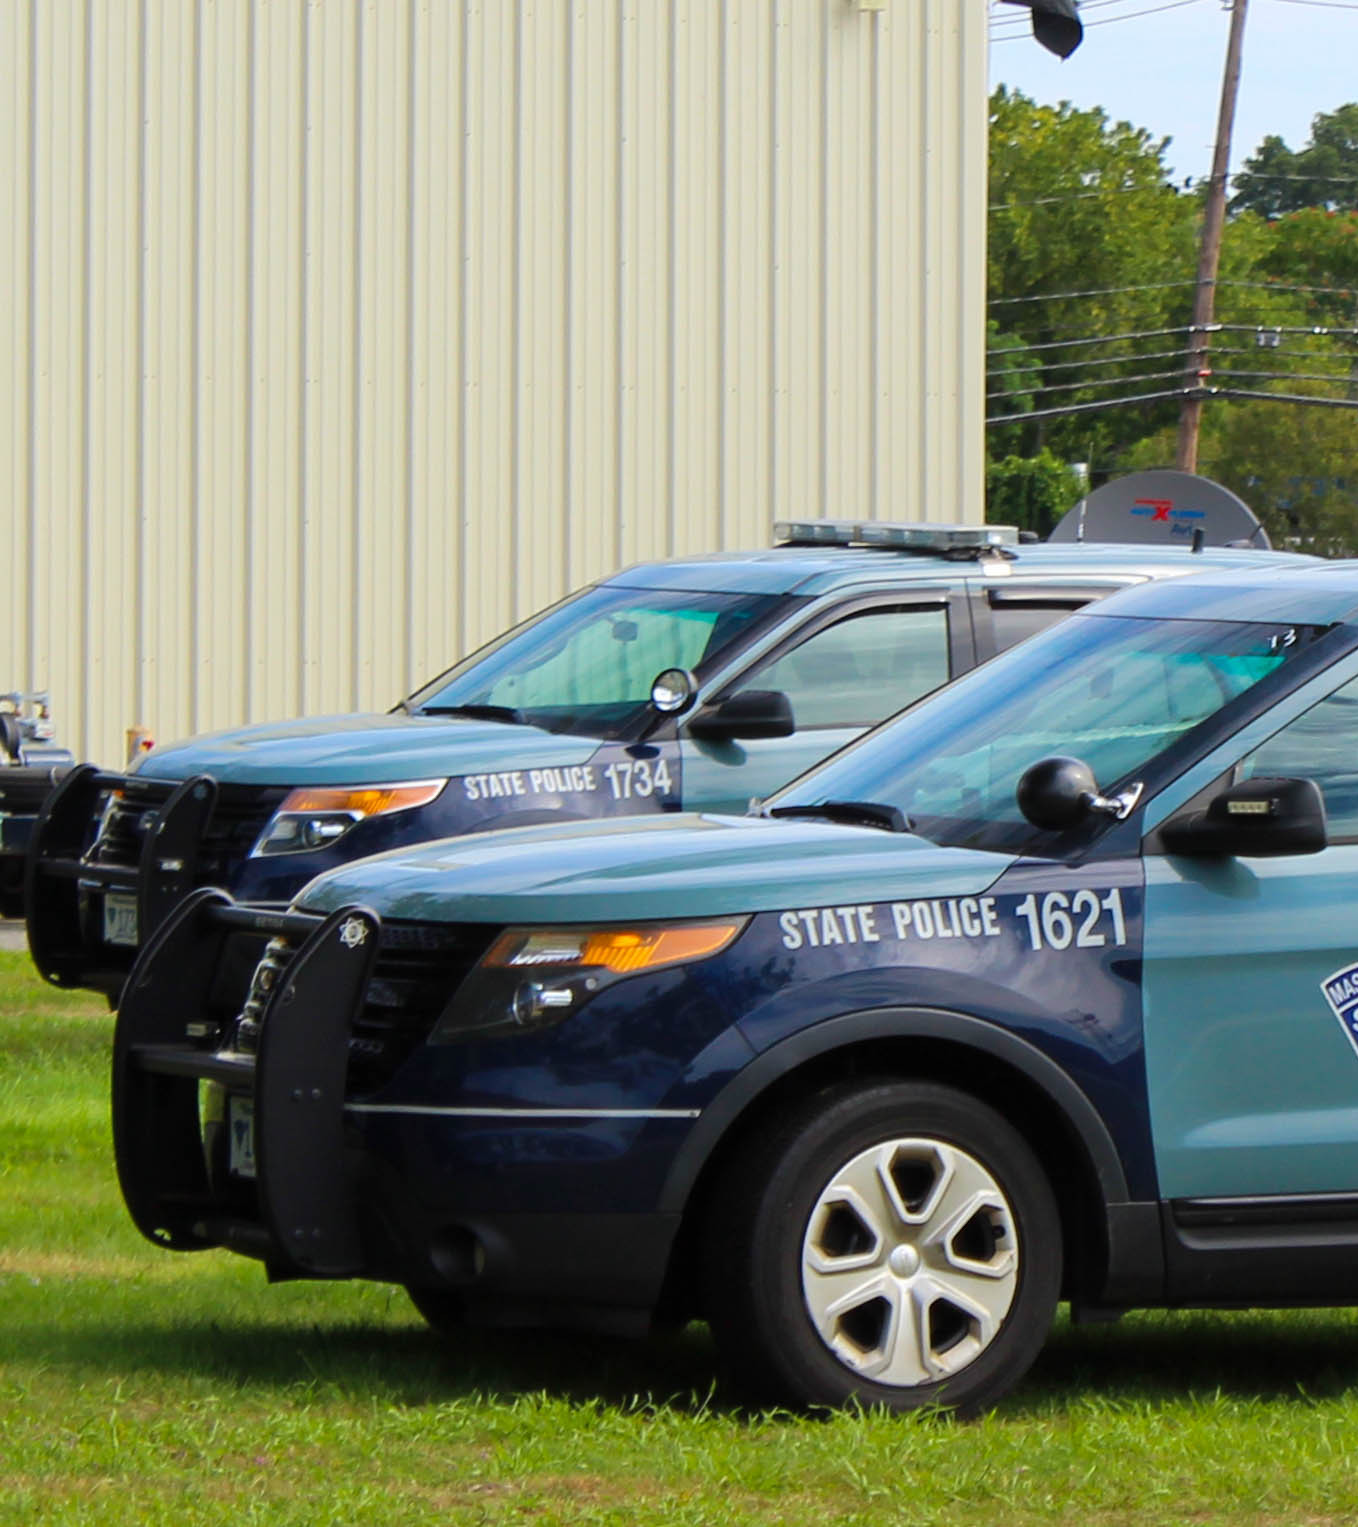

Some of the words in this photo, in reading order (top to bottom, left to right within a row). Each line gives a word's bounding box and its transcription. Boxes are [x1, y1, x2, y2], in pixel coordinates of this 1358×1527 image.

[464, 772, 526, 800] STATE
[529, 766, 596, 793] POLICE
[604, 759, 672, 799] 1734
[779, 905, 880, 950] STATE
[892, 897, 1001, 940] POLICE
[1016, 888, 1127, 951] 1621
